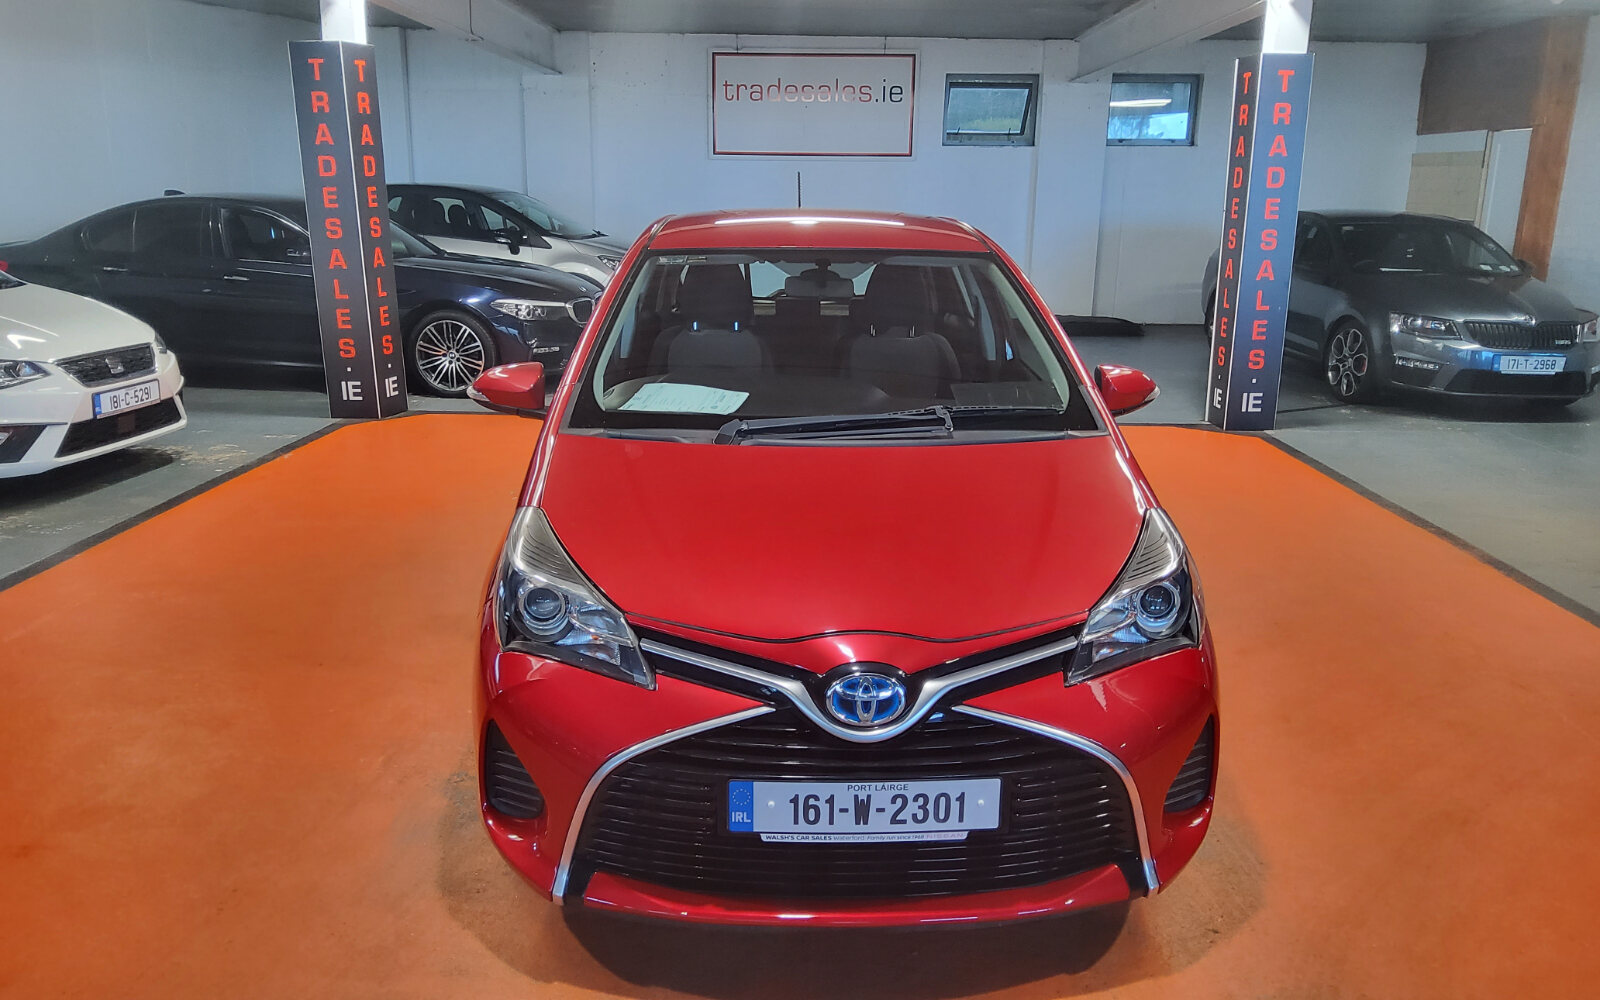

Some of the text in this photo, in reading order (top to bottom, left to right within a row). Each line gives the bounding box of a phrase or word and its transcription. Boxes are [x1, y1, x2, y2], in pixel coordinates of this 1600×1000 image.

[722, 77, 904, 103] tradesales.ie
[1507, 358, 1557, 370] 171-T-2968
[109, 385, 152, 410] 181-C-5291
[847, 783, 909, 792] PORT LÁIRGE
[731, 811, 752, 823] IRL
[789, 791, 966, 826] 161-W-2301
